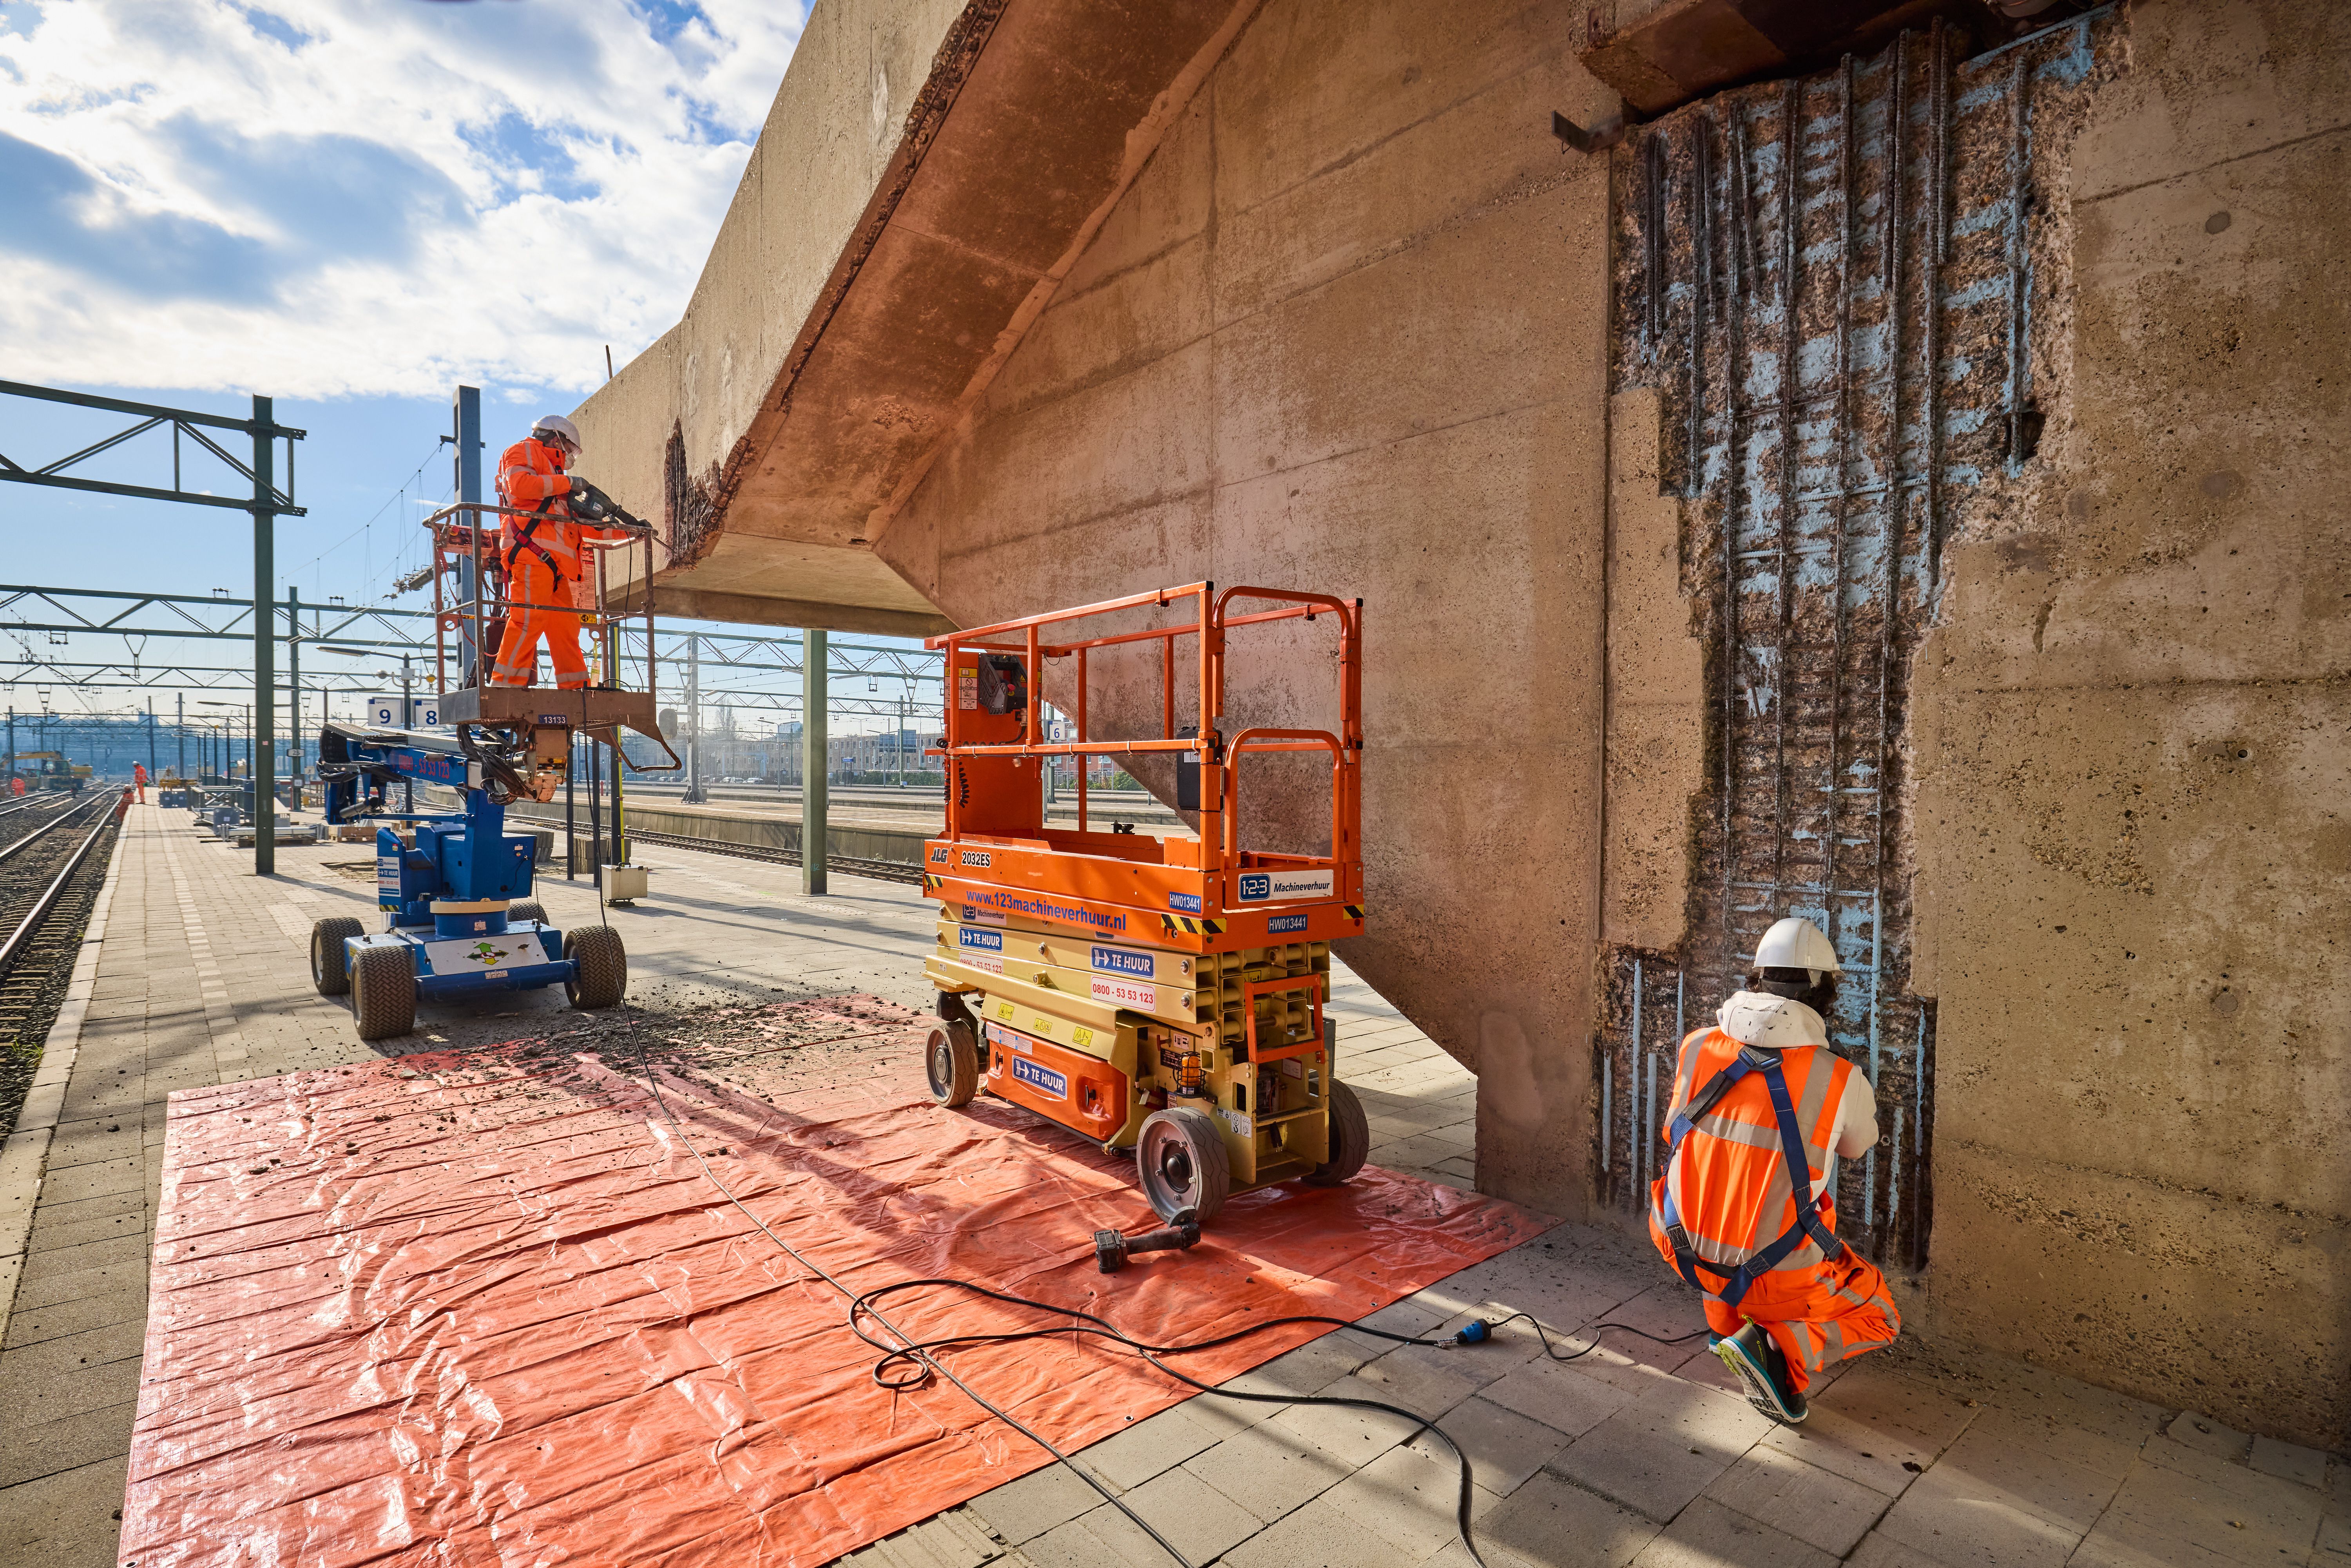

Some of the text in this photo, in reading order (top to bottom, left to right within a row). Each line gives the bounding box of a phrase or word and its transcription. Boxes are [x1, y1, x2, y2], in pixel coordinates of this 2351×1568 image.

[379, 709, 391, 724] 9
[426, 710, 437, 725] 8
[681, 724, 686, 732] 4
[1054, 728, 1060, 738] 6
[419, 758, 426, 774] 53
[428, 761, 435, 776] 53
[438, 761, 449, 779] 123
[931, 848, 948, 863] JLG
[962, 852, 990, 867] 2032ES
[1273, 881, 1330, 893] Machineverhuur
[1170, 894, 1200, 910] HW013441
[966, 891, 1126, 930] www.123machineverhuur.nl
[977, 909, 1005, 919] Machineverhuur
[1269, 917, 1306, 931] HW013441
[973, 933, 1000, 947] TE HUUR
[993, 964, 1002, 974] 123
[1112, 954, 1150, 972] TE HUUR
[1093, 983, 1110, 995] 0800
[1117, 988, 1125, 998] 53
[1128, 990, 1137, 1000] 53
[1139, 992, 1153, 1004] 123
[1031, 1068, 1063, 1092] TE HUUR
